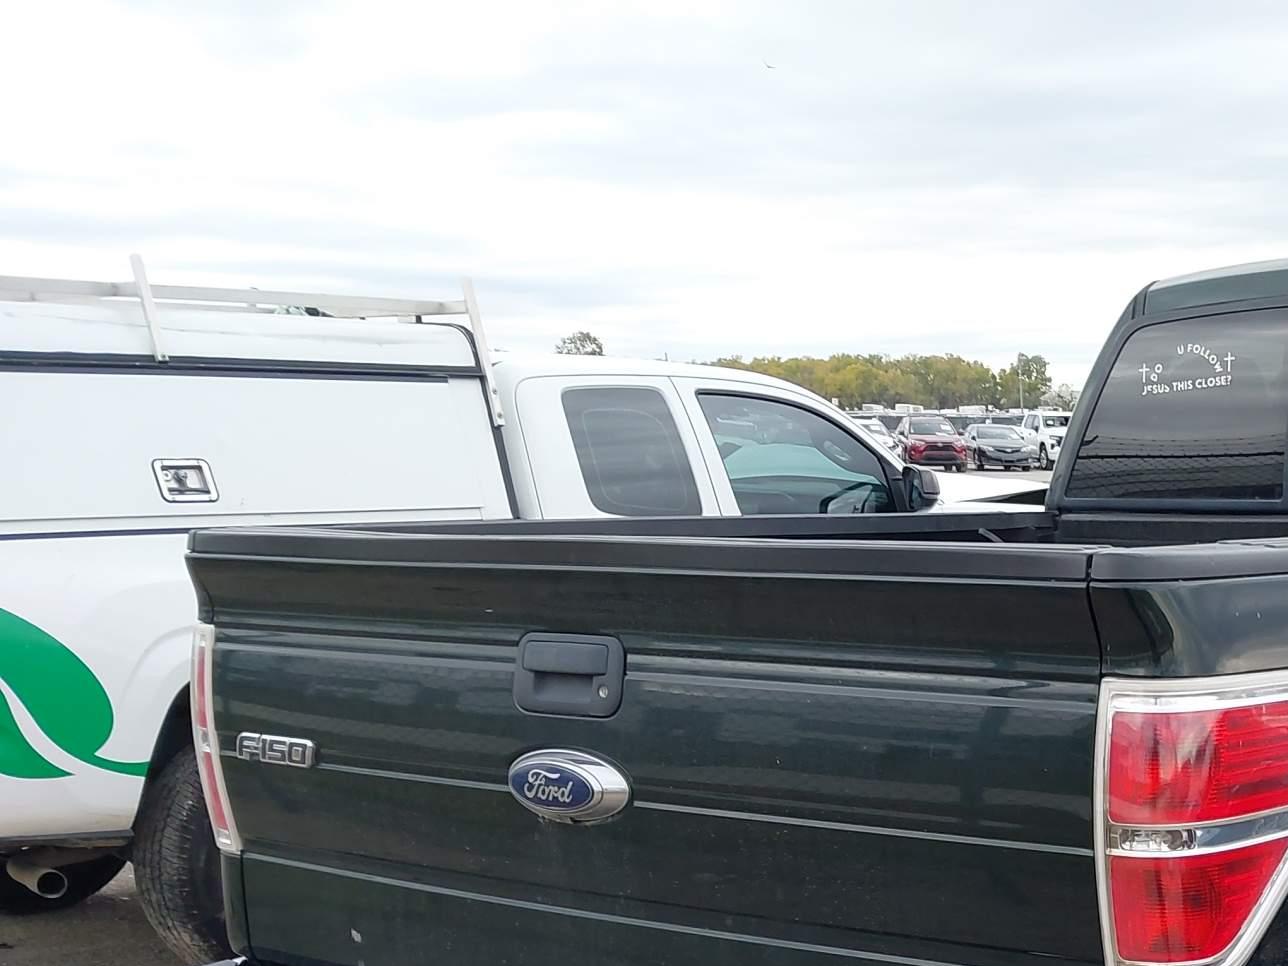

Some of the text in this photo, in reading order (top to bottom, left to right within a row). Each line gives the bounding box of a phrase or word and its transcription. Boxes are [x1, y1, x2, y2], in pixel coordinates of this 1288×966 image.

[1187, 343, 1223, 373] FOLLOW
[1172, 380, 1193, 392] THIS
[1195, 375, 1232, 388] CLOSE?
[523, 769, 573, 803] Ford
